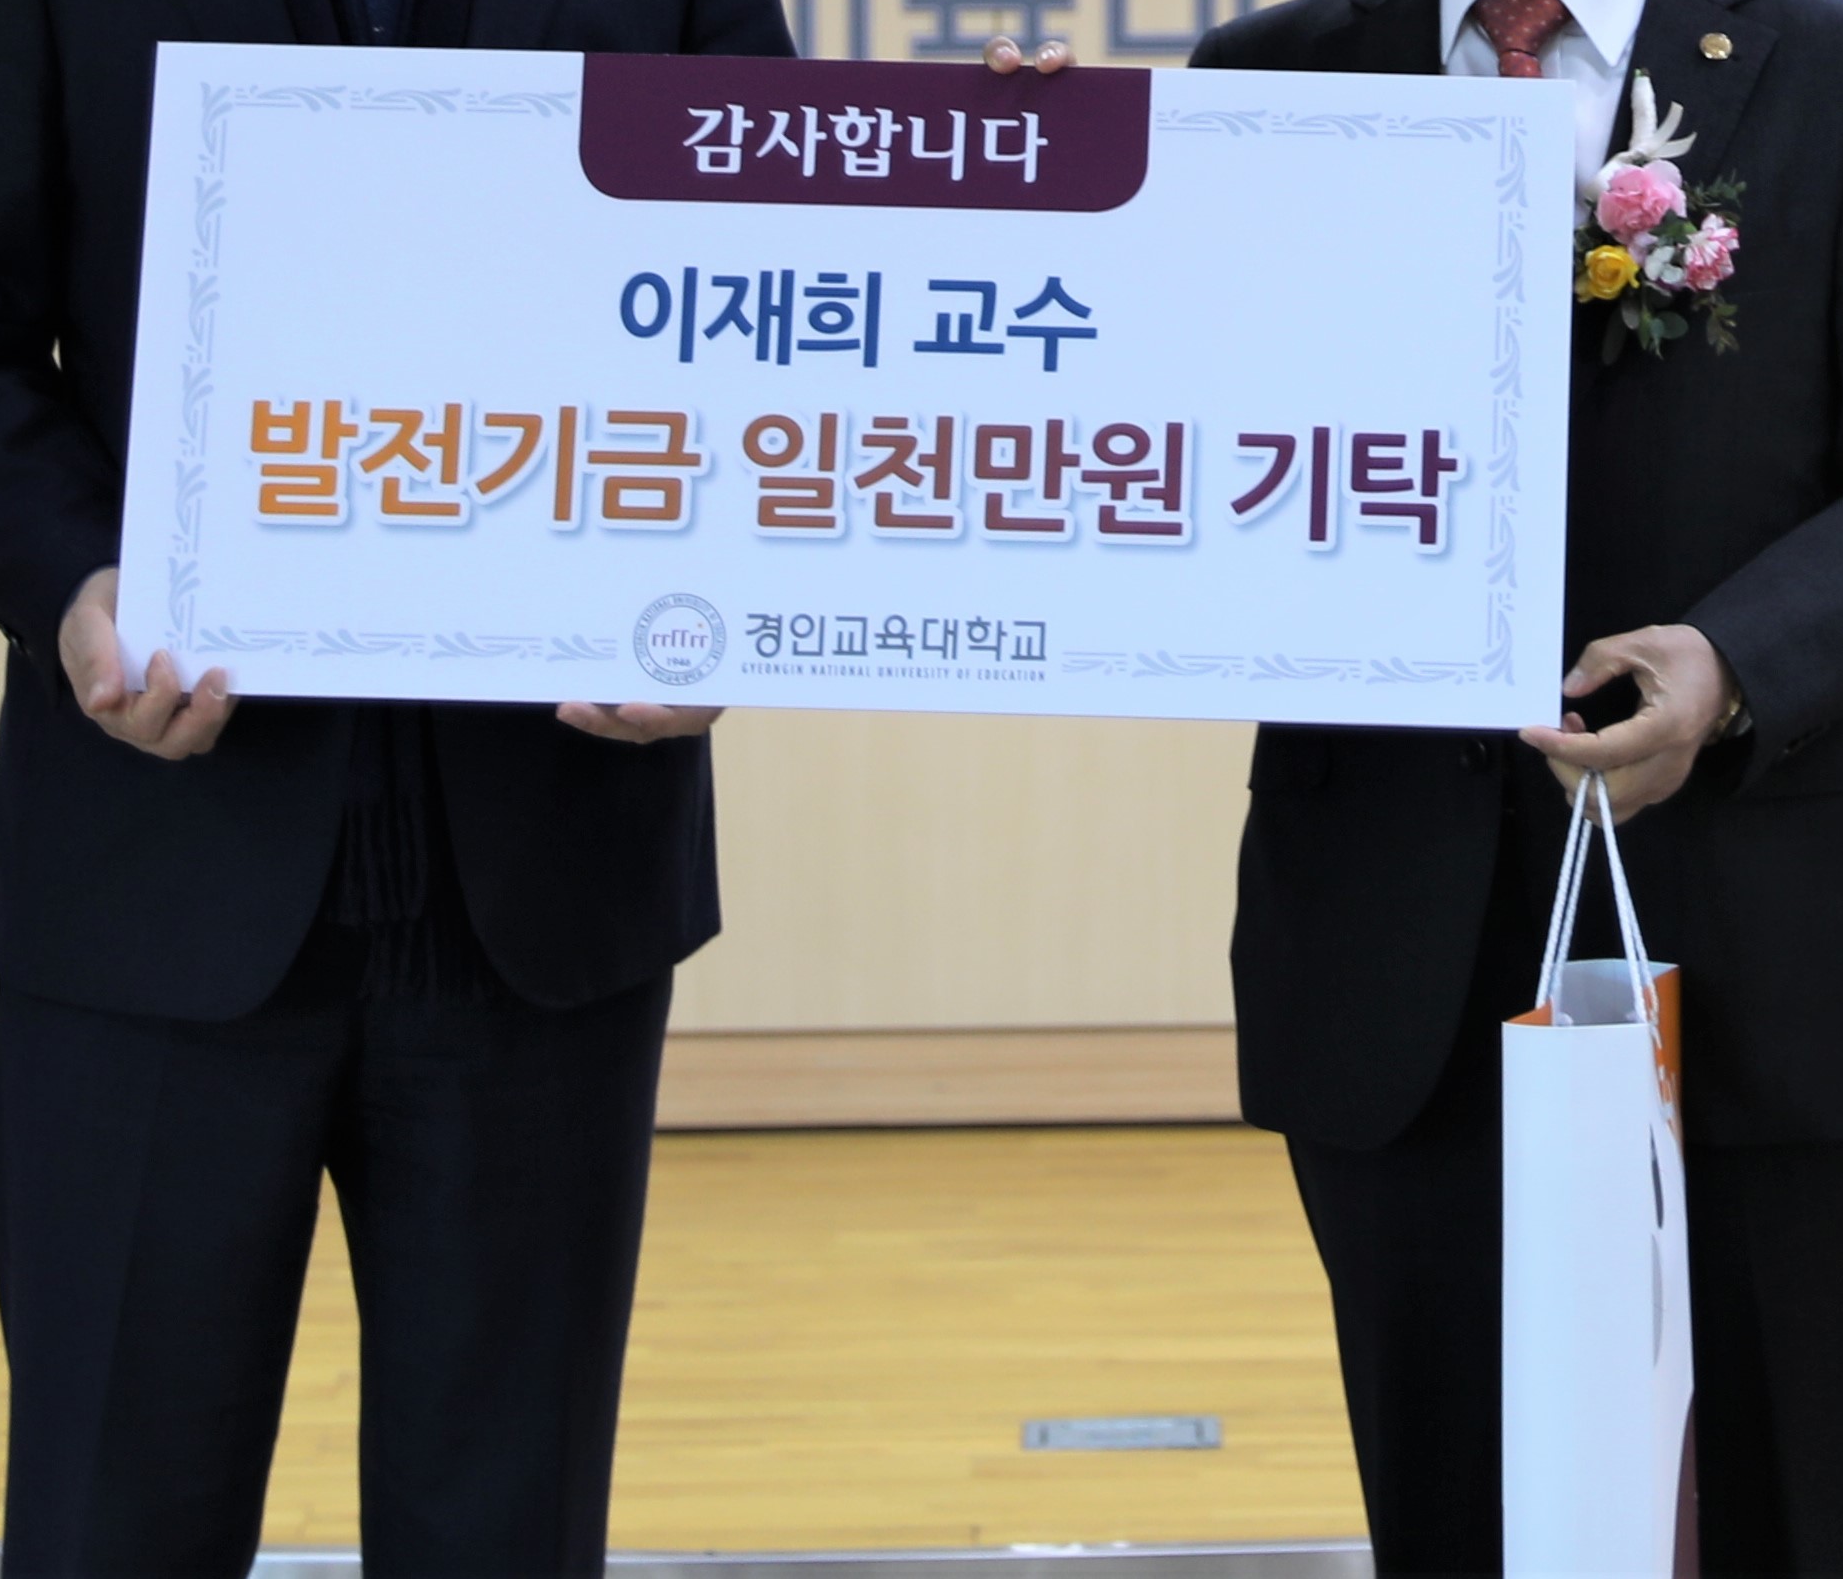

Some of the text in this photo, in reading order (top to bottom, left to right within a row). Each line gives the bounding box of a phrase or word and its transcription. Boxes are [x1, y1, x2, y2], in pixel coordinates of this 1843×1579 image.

[683, 104, 1048, 183] 감사합니다
[620, 267, 1097, 372] 이재희 교수
[251, 400, 1457, 545] 발전기금 일천만원 기탁
[741, 662, 1045, 682] GYEONGIN NATIONAL UNIVERSITY OF EDUCATION
[746, 614, 1046, 661] 경인교육대학교
